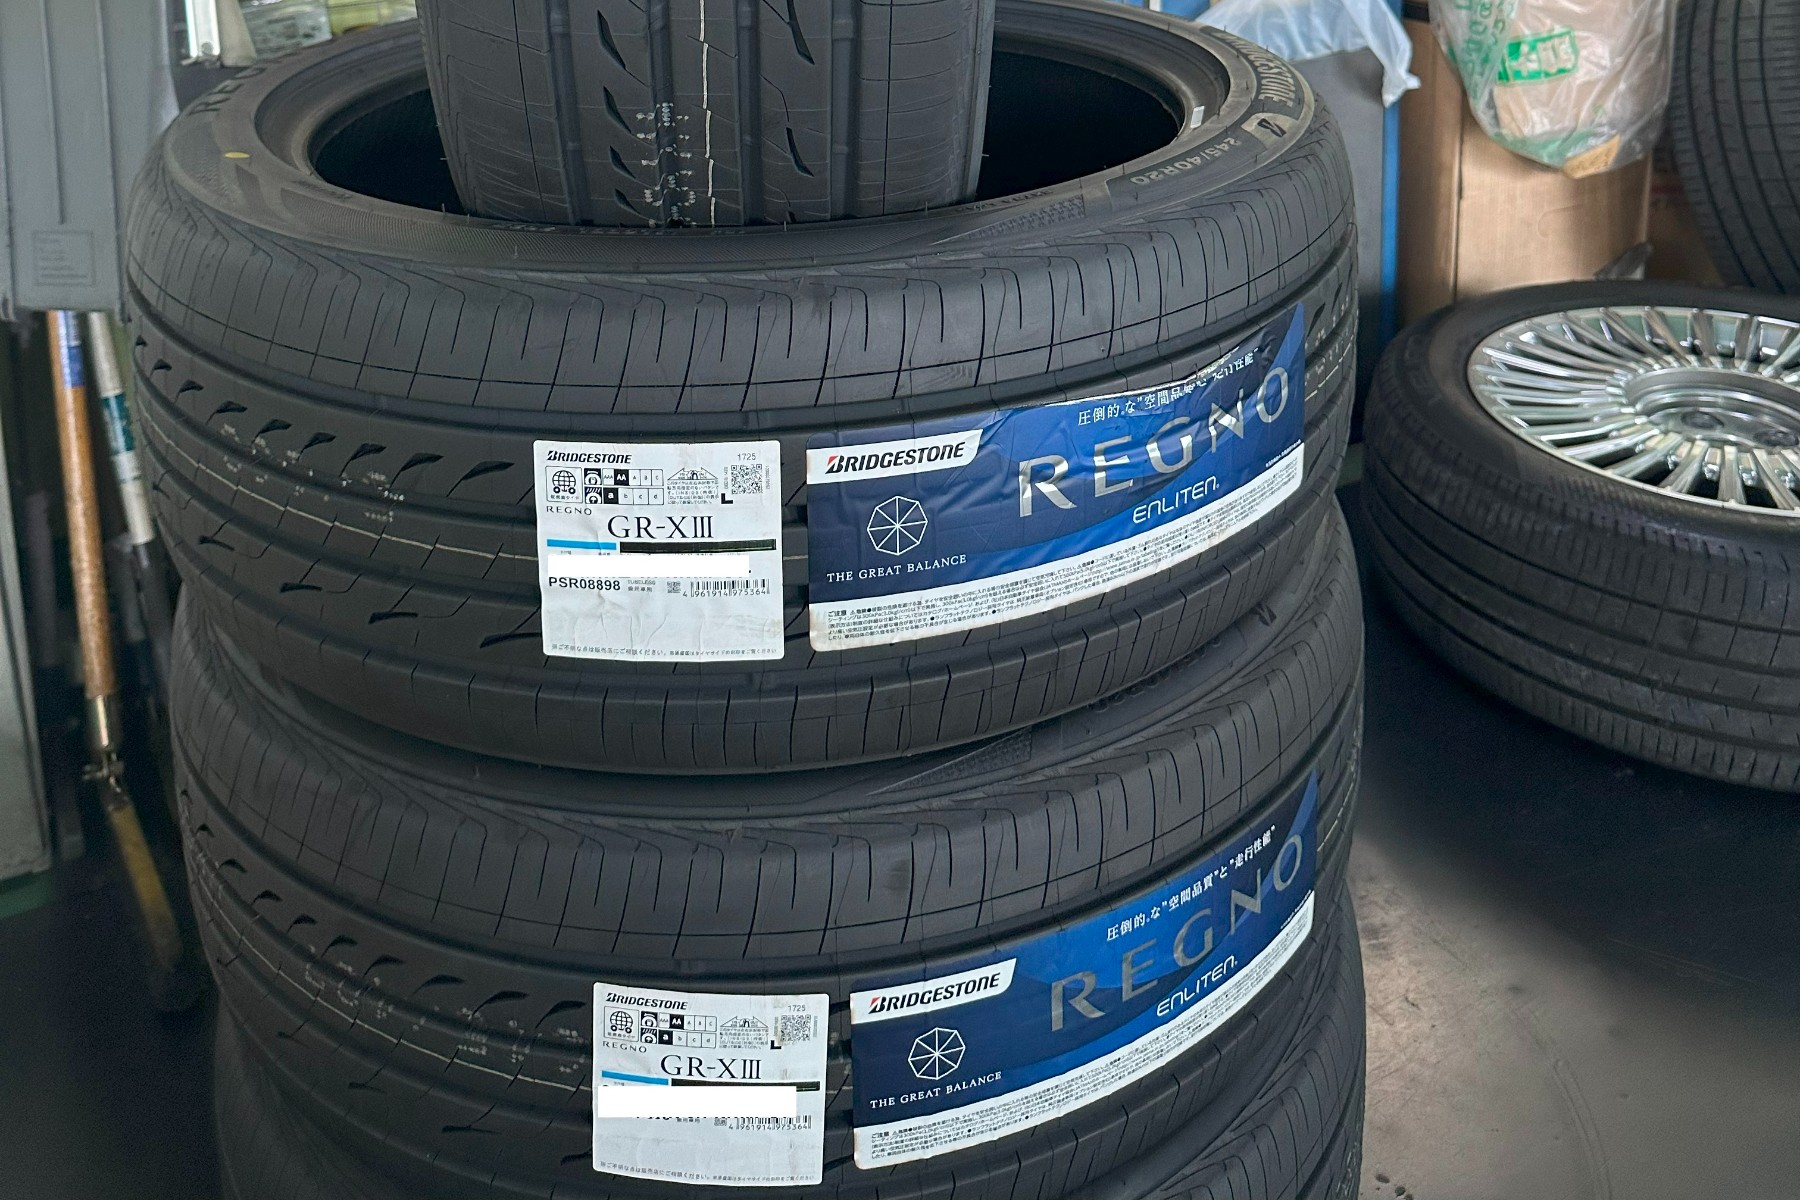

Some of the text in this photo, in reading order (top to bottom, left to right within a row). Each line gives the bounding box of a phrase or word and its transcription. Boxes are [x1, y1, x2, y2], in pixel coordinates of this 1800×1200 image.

[1130, 136, 1243, 186] 245/40R20
[1018, 366, 1289, 518] REGNO
[546, 450, 632, 464] BRIDGESTONE
[737, 452, 757, 461] 1725
[825, 441, 966, 475] BRIDGESTONE
[616, 473, 627, 482] AA
[607, 491, 614, 499] a
[720, 493, 734, 504] L
[1132, 475, 1217, 524] ENLITEN
[546, 505, 592, 516] REGNO
[607, 515, 714, 539] GR-XIII
[826, 554, 967, 583] THE GREAT BALANCE
[548, 577, 621, 591] PSR08898
[694, 589, 728, 598] 961914
[732, 589, 767, 597] 975364
[1051, 834, 1303, 1032] REGNO
[1156, 954, 1235, 1018] ENLITEN
[868, 972, 1001, 1015] BRIDGESTONE
[606, 992, 688, 1011] BRIDGESTONE
[787, 1004, 806, 1012] 1725
[671, 1017, 682, 1026] AA
[662, 1033, 669, 1041] a
[602, 1040, 647, 1053] REGNO
[660, 1054, 762, 1079] GR-XIII
[870, 1071, 1002, 1109] THE GREAT BALANCE
[739, 1123, 772, 1131] 961914
